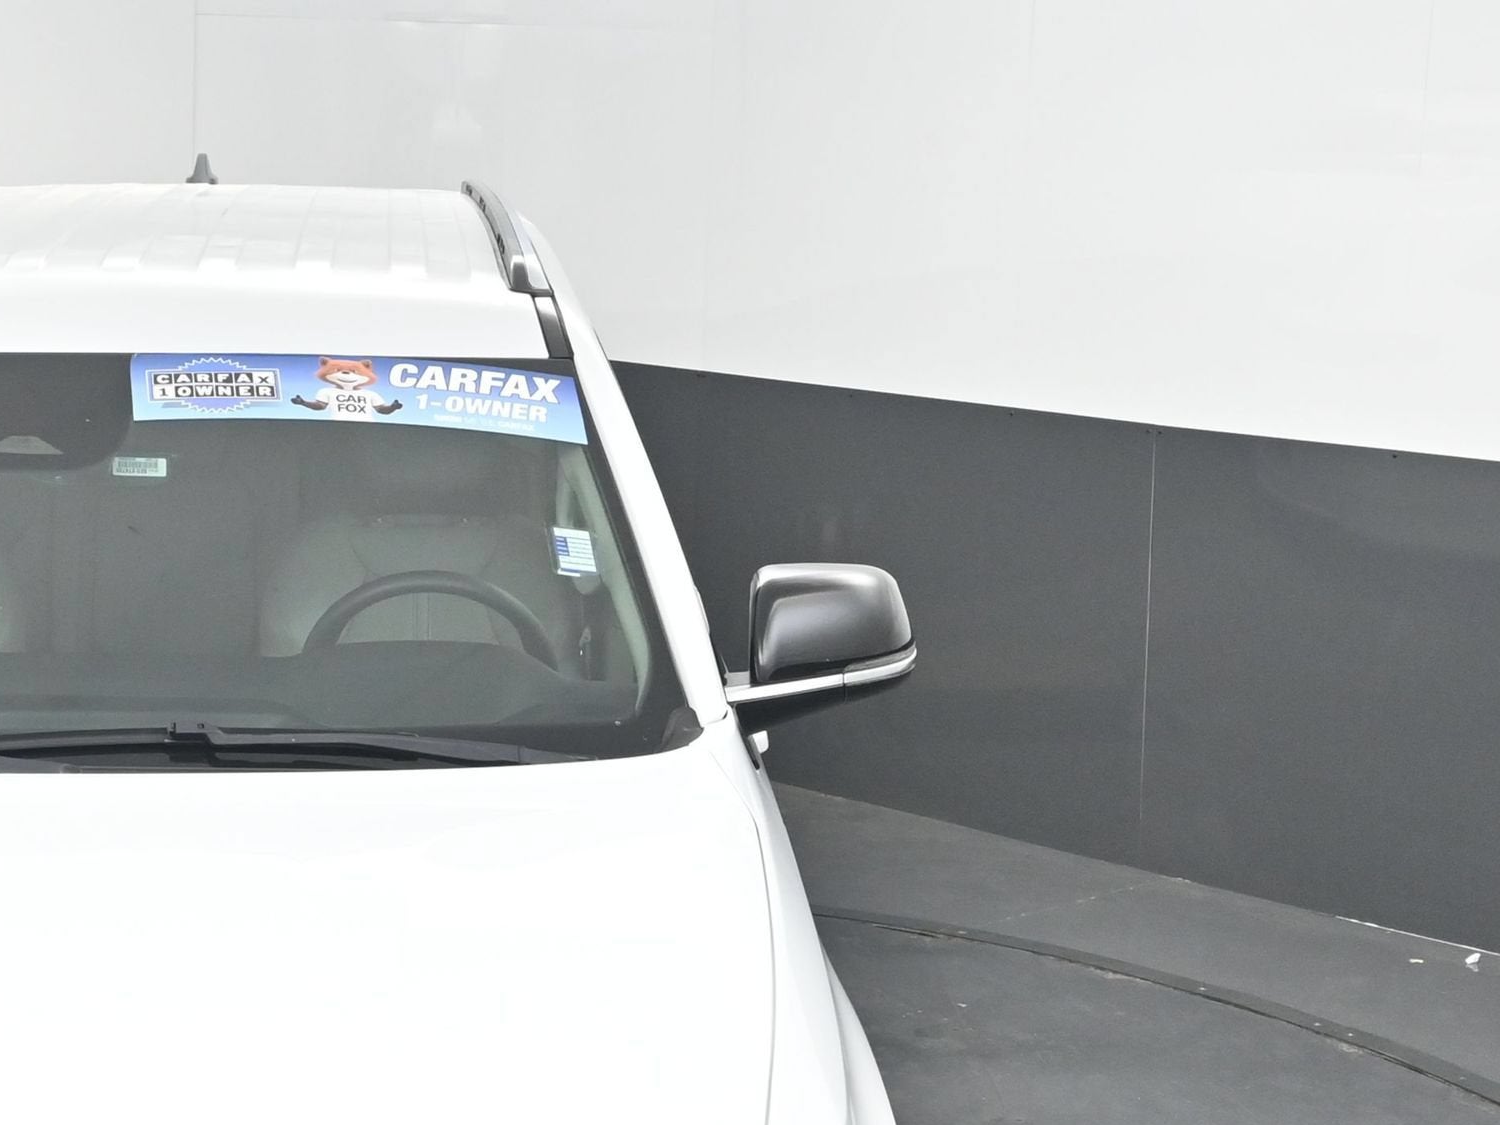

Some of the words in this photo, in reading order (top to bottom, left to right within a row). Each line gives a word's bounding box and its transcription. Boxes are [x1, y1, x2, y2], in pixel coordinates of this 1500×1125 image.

[155, 373, 270, 384] CARFAX
[389, 363, 560, 403] CARFAX
[177, 386, 273, 397] OWNER
[336, 394, 367, 404] CAR
[337, 403, 366, 414] FOX
[416, 394, 548, 422] 1-OWNER
